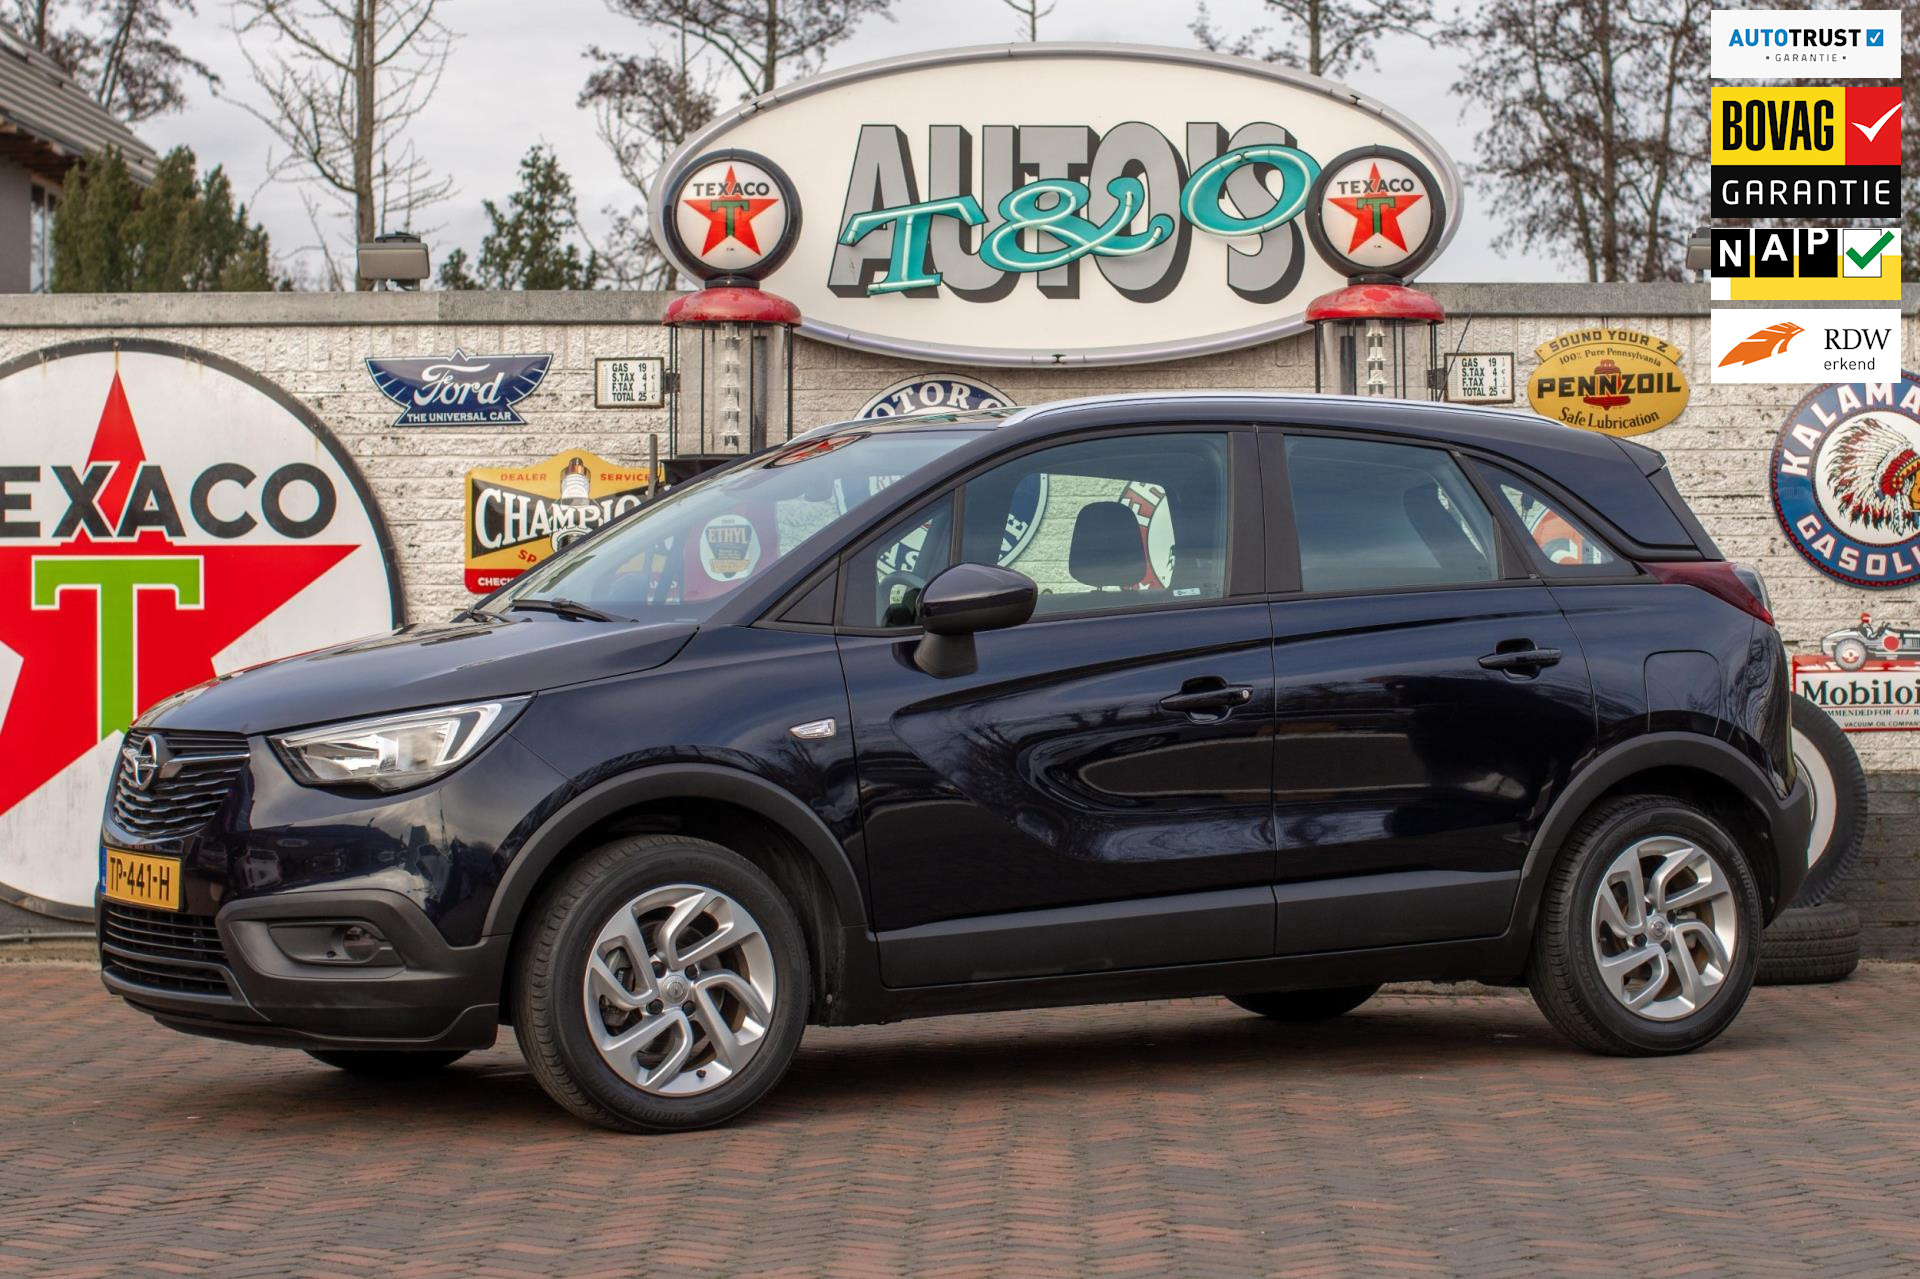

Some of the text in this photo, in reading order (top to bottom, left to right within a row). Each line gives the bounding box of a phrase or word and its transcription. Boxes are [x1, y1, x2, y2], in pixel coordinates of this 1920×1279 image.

[693, 182, 770, 196] TEXACO
[1337, 178, 1415, 194] TEXACO
[827, 121, 1306, 303] AUTO'S
[1549, 331, 1669, 353] SOUND YOUR Z
[1462, 358, 1496, 367] GAS 19
[1585, 349, 1606, 358] Pure
[1607, 348, 1661, 367] Pennsylvania
[612, 363, 647, 372] GAS 19
[1462, 368, 1485, 377] S.TAX
[414, 363, 505, 406] Ford
[612, 373, 635, 382] S.TAX
[1462, 378, 1484, 387] F.TAX
[1538, 372, 1681, 399] PENNZOIL
[612, 383, 633, 392] F.TAX
[1462, 387, 1498, 397] TOTAL 25
[612, 392, 647, 402] TOTAL 25
[871, 381, 971, 418] OTOR
[407, 411, 511, 422] THE UNIVERSAL CAR
[1558, 406, 1660, 429] Safe Lubrication
[1781, 383, 1920, 476] KALAMA
[500, 473, 547, 481] DEALER
[0, 463, 337, 539] EXACO
[475, 488, 648, 549] CHAMPIO
[708, 528, 748, 544] ETHYL
[1802, 680, 1920, 705] Mobiloi
[110, 857, 169, 901] TP-441-H
